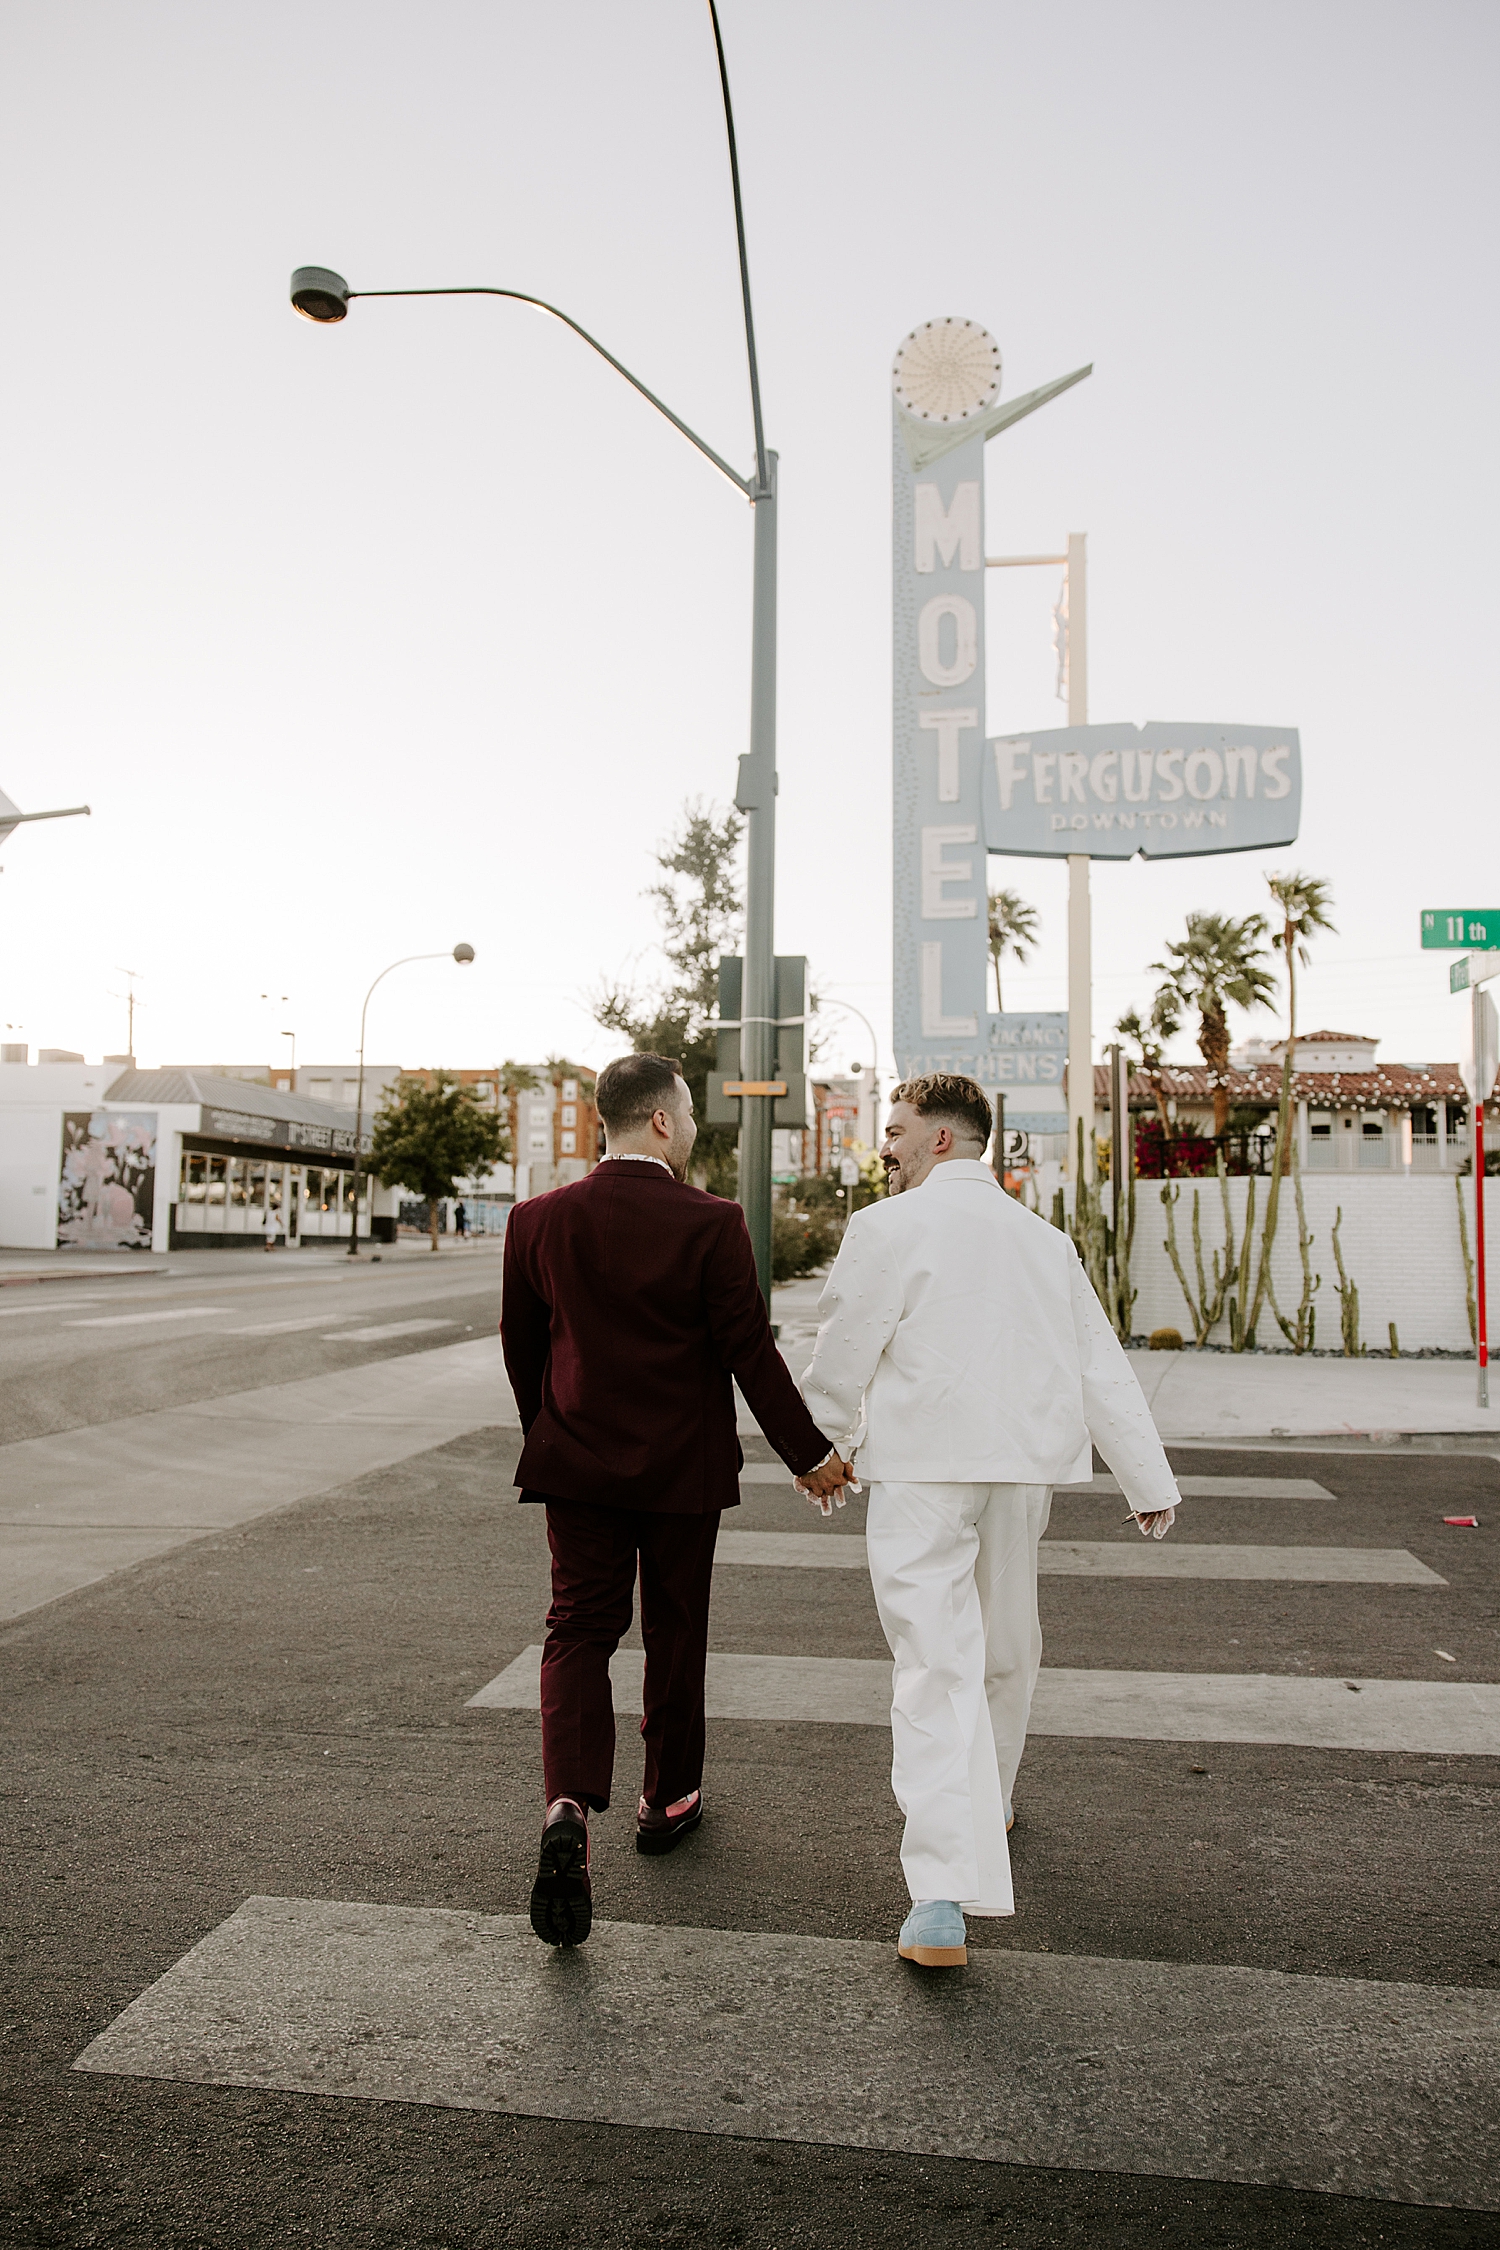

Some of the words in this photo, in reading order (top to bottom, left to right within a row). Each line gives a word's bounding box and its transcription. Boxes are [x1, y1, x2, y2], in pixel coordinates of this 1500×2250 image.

[914, 480, 981, 1038] MOTEL
[994, 740, 1292, 810] FERGUSONS
[1051, 812, 1228, 831] DOWNTOWN
[1424, 913, 1435, 929] N
[903, 1053, 1058, 1081] KITCHENS
